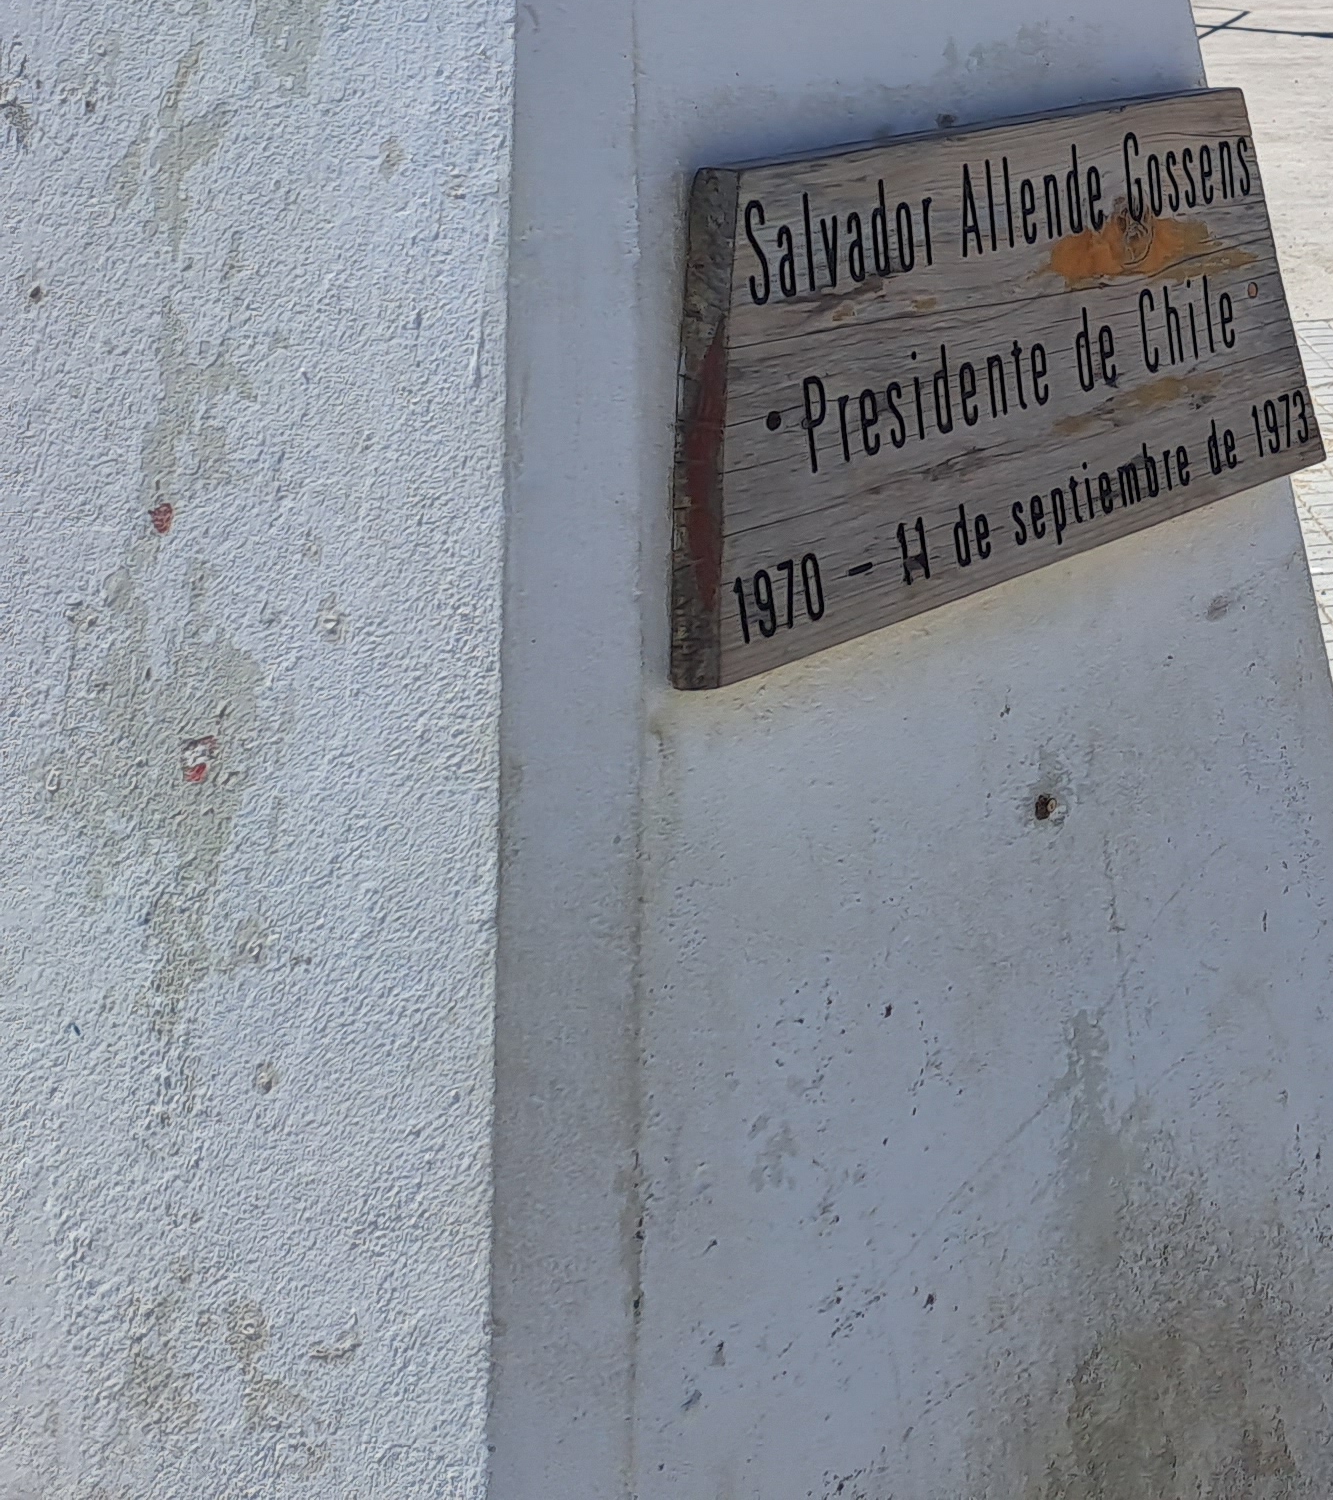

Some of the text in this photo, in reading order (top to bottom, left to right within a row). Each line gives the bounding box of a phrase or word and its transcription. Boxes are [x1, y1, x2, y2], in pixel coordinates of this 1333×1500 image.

[744, 132, 1250, 306] Salvador Allende Gossens
[802, 274, 1236, 473] Presidente de Chile
[733, 552, 825, 644] 1970
[953, 503, 992, 568] de
[1011, 442, 1191, 546] septiembre
[1207, 418, 1237, 476] de
[1251, 389, 1309, 458] 1973
